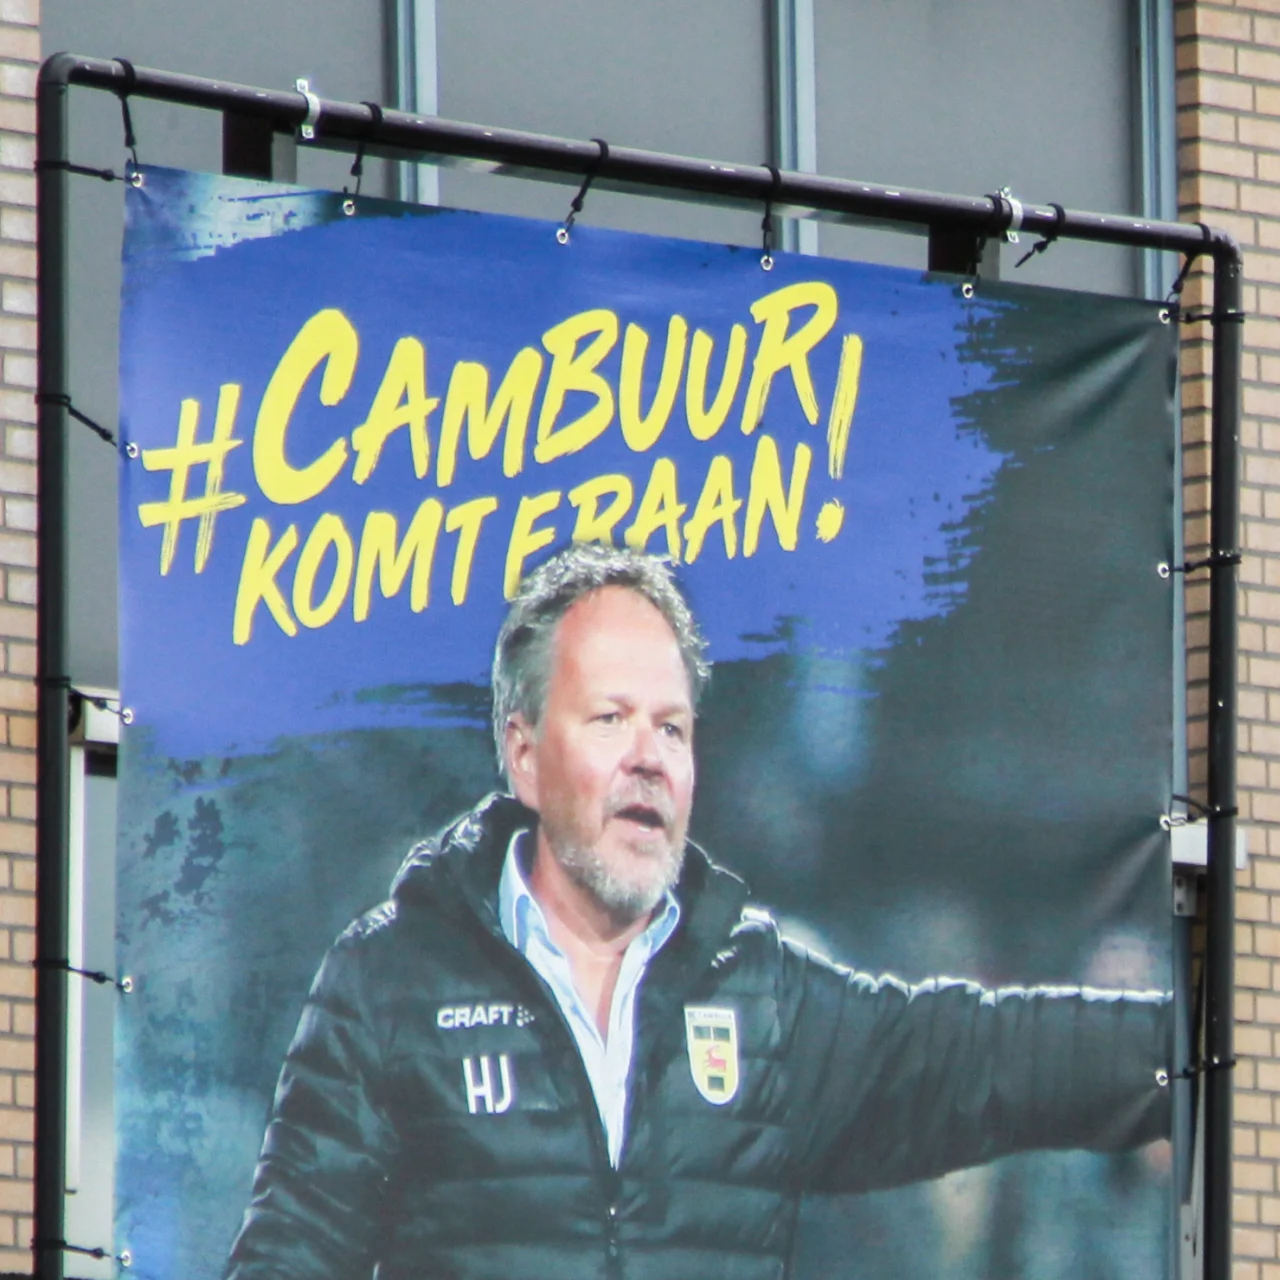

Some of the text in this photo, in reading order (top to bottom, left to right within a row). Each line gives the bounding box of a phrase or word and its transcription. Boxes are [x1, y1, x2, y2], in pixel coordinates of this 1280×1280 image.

[232, 494, 497, 645] KOMT
[436, 1005, 514, 1029] CRAFT
[463, 1055, 513, 1114] HJ
